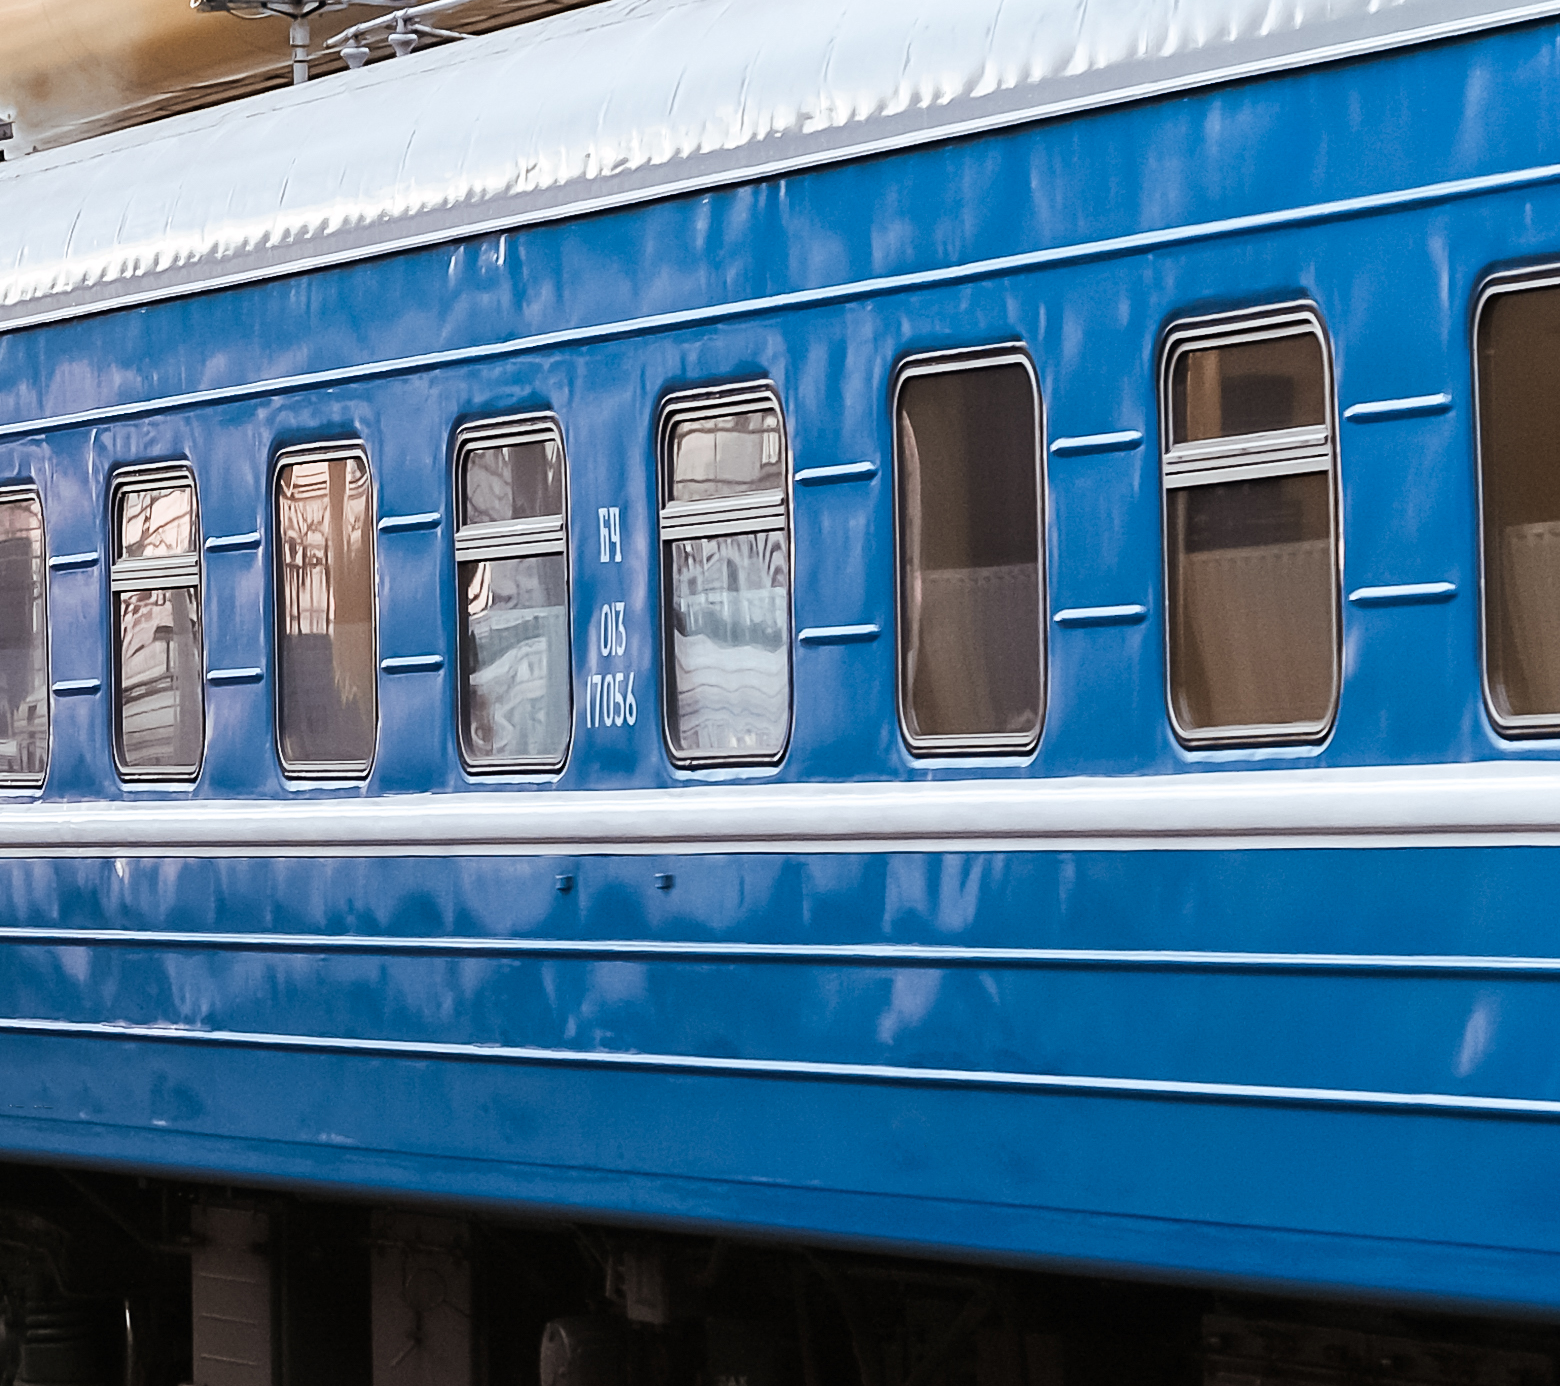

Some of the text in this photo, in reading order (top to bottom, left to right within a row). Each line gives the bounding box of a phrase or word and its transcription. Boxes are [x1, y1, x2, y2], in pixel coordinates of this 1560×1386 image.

[598, 507, 622, 563] БЧ
[600, 602, 626, 656] 013
[586, 671, 637, 729] 17056
